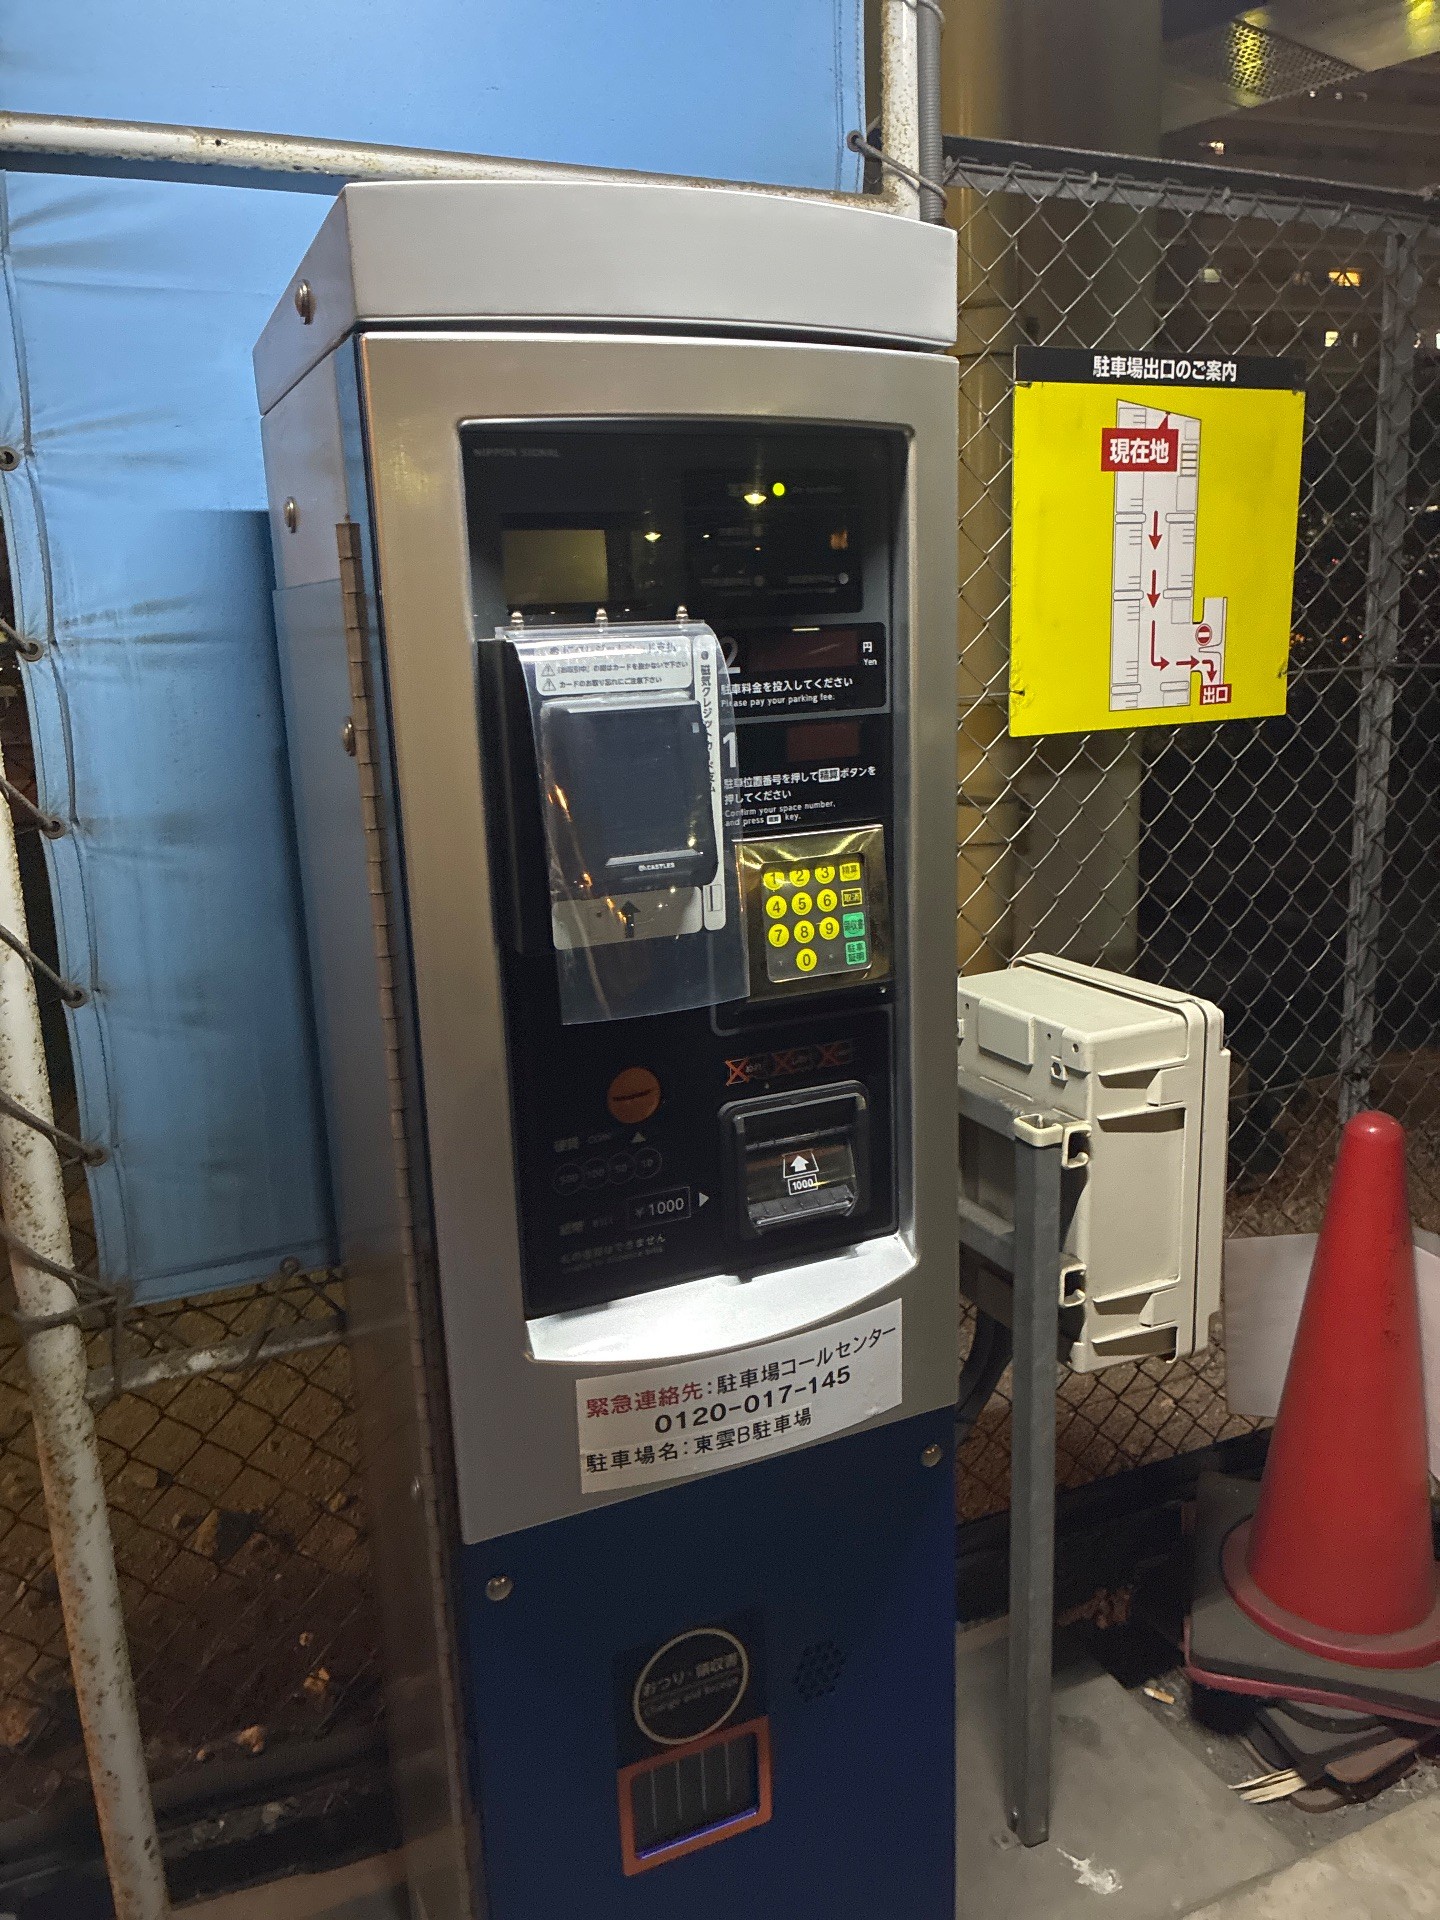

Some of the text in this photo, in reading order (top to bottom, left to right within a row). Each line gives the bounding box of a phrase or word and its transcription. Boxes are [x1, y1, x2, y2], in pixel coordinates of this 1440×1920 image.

[1092, 355, 1237, 382] 駐車場出口のご案内
[1109, 437, 1170, 464] 現在地
[862, 641, 873, 653] 円
[863, 658, 877, 666] Yen
[720, 677, 853, 696] 駐車料金を投入してください
[1202, 685, 1229, 703] 出口
[720, 698, 748, 708] Please
[750, 698, 765, 708] pay
[767, 695, 786, 706] your
[788, 693, 818, 705] parking
[723, 731, 738, 768] 1
[724, 789, 792, 806] 押してください
[725, 806, 757, 818] Confirm
[759, 805, 777, 816] your
[779, 803, 802, 816] space
[725, 817, 741, 828] and
[743, 816, 765, 828] press
[795, 869, 804, 882] 2
[821, 866, 830, 879] 3
[772, 901, 781, 913] 4
[798, 897, 806, 910] 5
[823, 894, 832, 907] 6
[774, 929, 783, 942] 7
[800, 926, 809, 938] 8
[825, 922, 834, 935] 9
[802, 954, 811, 966] 0
[792, 1177, 814, 1191] 1000
[655, 1365, 851, 1434] 0120-017-145
